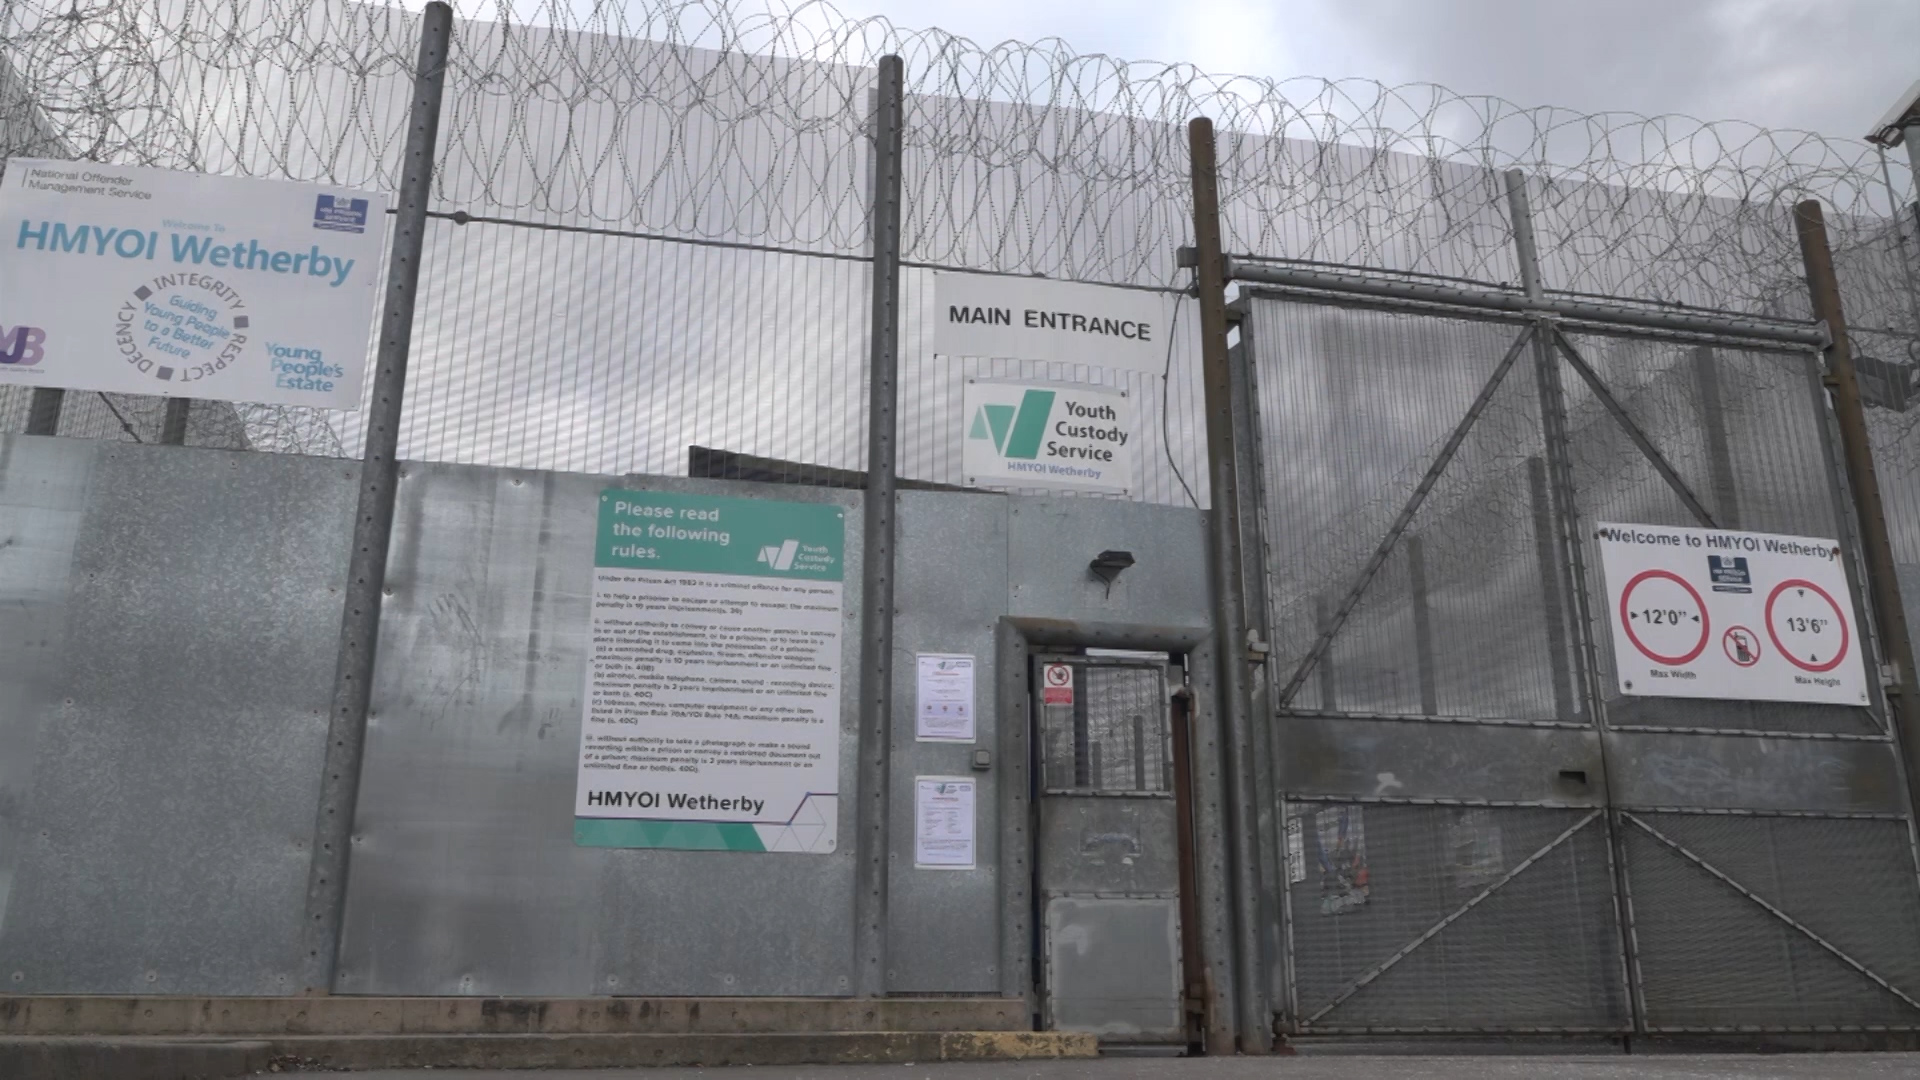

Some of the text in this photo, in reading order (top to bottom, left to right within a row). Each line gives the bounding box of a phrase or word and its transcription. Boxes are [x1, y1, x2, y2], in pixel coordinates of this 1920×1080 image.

[31, 168, 133, 187] National Offender
[28, 180, 152, 200] Management Service
[162, 219, 209, 232] Welcome
[17, 220, 355, 287] HMYOI Wetherby
[152, 272, 246, 310] INTEGRITY
[169, 295, 218, 322] Guiding
[144, 302, 230, 339] Young People
[950, 306, 1151, 341] MAIN ENTRANCE
[116, 301, 154, 373] DECENCY
[144, 320, 214, 350] to a Better
[148, 336, 191, 359] Future
[180, 333, 248, 382] RESPECT
[265, 342, 322, 364] Young
[270, 356, 344, 378] People's
[276, 374, 334, 392] Estate
[1066, 401, 1116, 421] Youth
[1056, 421, 1128, 446] Custody
[1047, 441, 1112, 462] Service
[1008, 462, 1102, 480] HMYOI Wetherby
[614, 501, 719, 522] Please read
[613, 522, 730, 546] the following
[1606, 528, 1835, 561] Welcome to HMYOI Wetherby
[612, 544, 660, 559] rules.
[1650, 669, 1696, 680] Max Width
[1795, 675, 1841, 687] Max Height
[588, 791, 764, 816] HMYOI Wetherby
